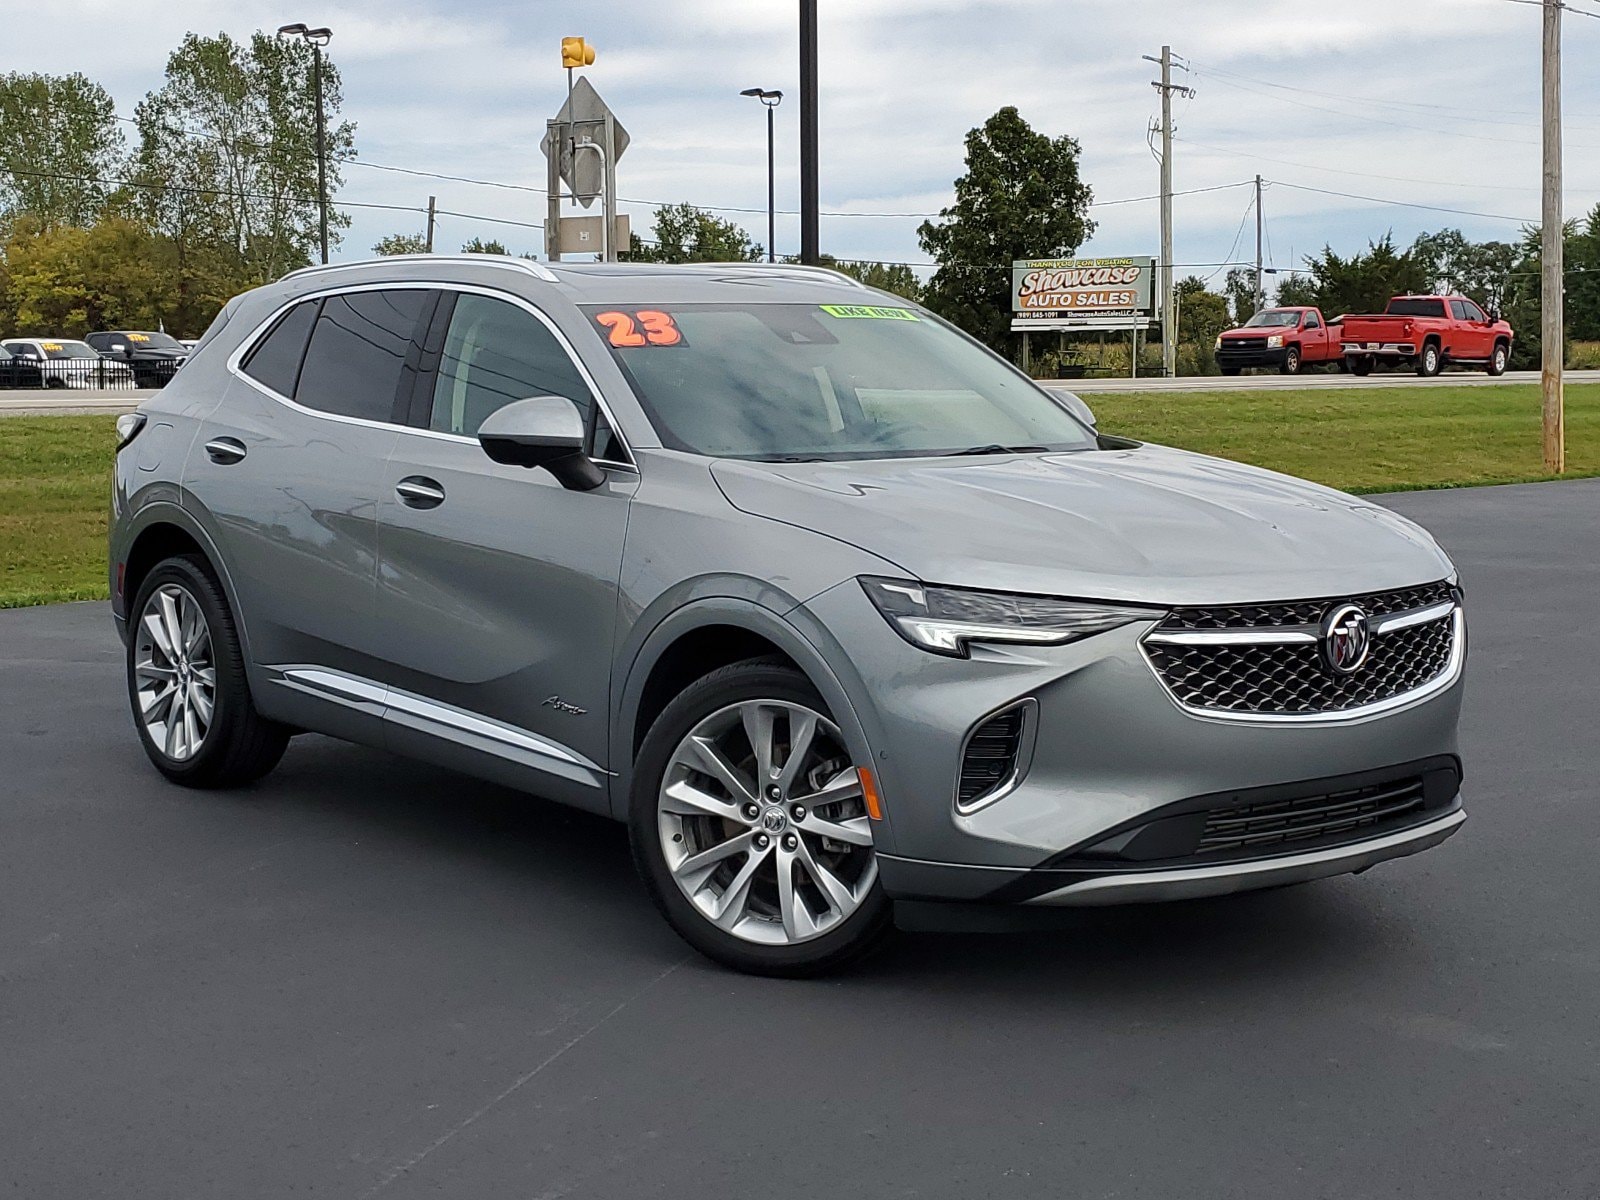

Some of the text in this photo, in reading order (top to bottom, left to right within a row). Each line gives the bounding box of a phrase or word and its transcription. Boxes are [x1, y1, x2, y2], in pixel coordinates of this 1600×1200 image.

[1095, 258, 1133, 266] VISITING
[1018, 266, 1141, 297] Showcase
[1027, 294, 1072, 307] AUTO
[831, 307, 910, 319] LIKE NEW
[596, 311, 681, 347] 23
